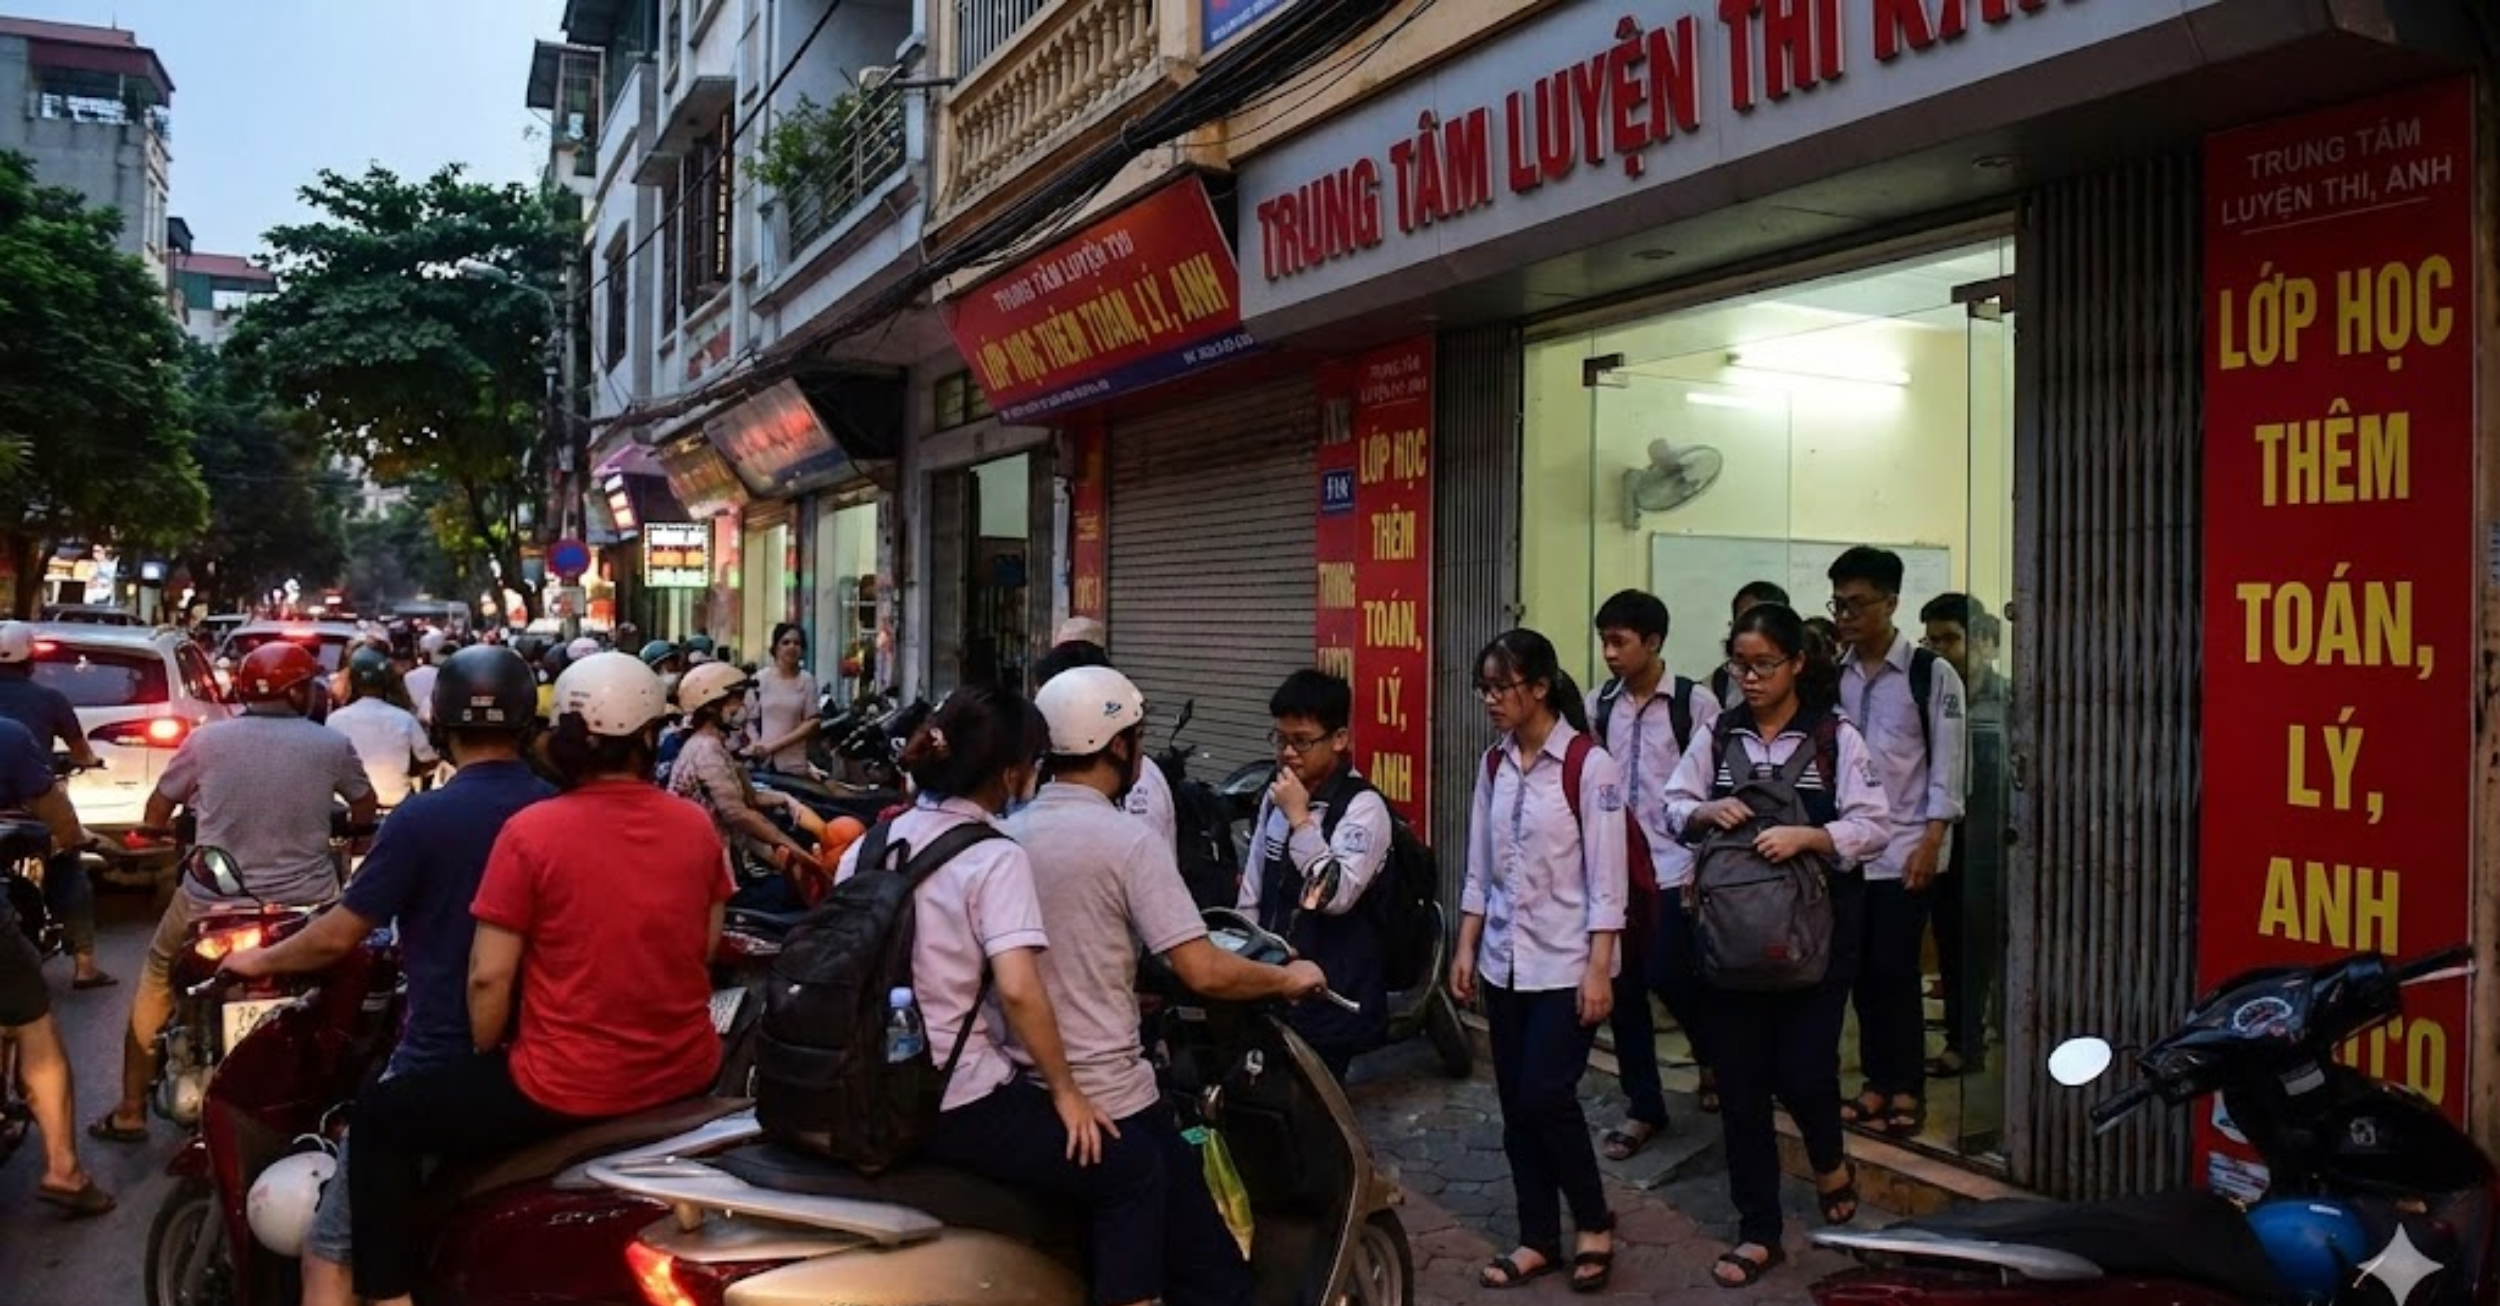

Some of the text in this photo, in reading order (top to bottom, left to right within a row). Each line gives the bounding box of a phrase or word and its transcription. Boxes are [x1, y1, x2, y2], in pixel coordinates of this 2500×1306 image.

[1257, 157, 1383, 281] TRUNG
[1389, 107, 1493, 233] TÂM
[1505, 15, 1699, 182] LUYỆN
[1717, 0, 1844, 112] THI
[2247, 136, 2346, 180] TRUNG
[2221, 154, 2452, 226] LUYỆN THI, ANH
[1077, 285, 1151, 352] TOÁN,
[1133, 262, 1183, 333] LÝ,
[1169, 252, 1230, 322] ANH
[2219, 254, 2454, 372] LỚP HỌC
[1358, 425, 1391, 485] LỚP
[1393, 427, 1427, 490] HỌC
[2254, 397, 2410, 507] THÊM
[1371, 502, 1416, 561] THÊM
[1362, 588, 1423, 652] TOÁN,
[2236, 562, 2435, 680] TOÁN,
[1376, 666, 1407, 733] LÝ,
[1370, 751, 1412, 802] ANH
[2287, 706, 2383, 825] LÝ,
[2257, 856, 2399, 957] ANH
